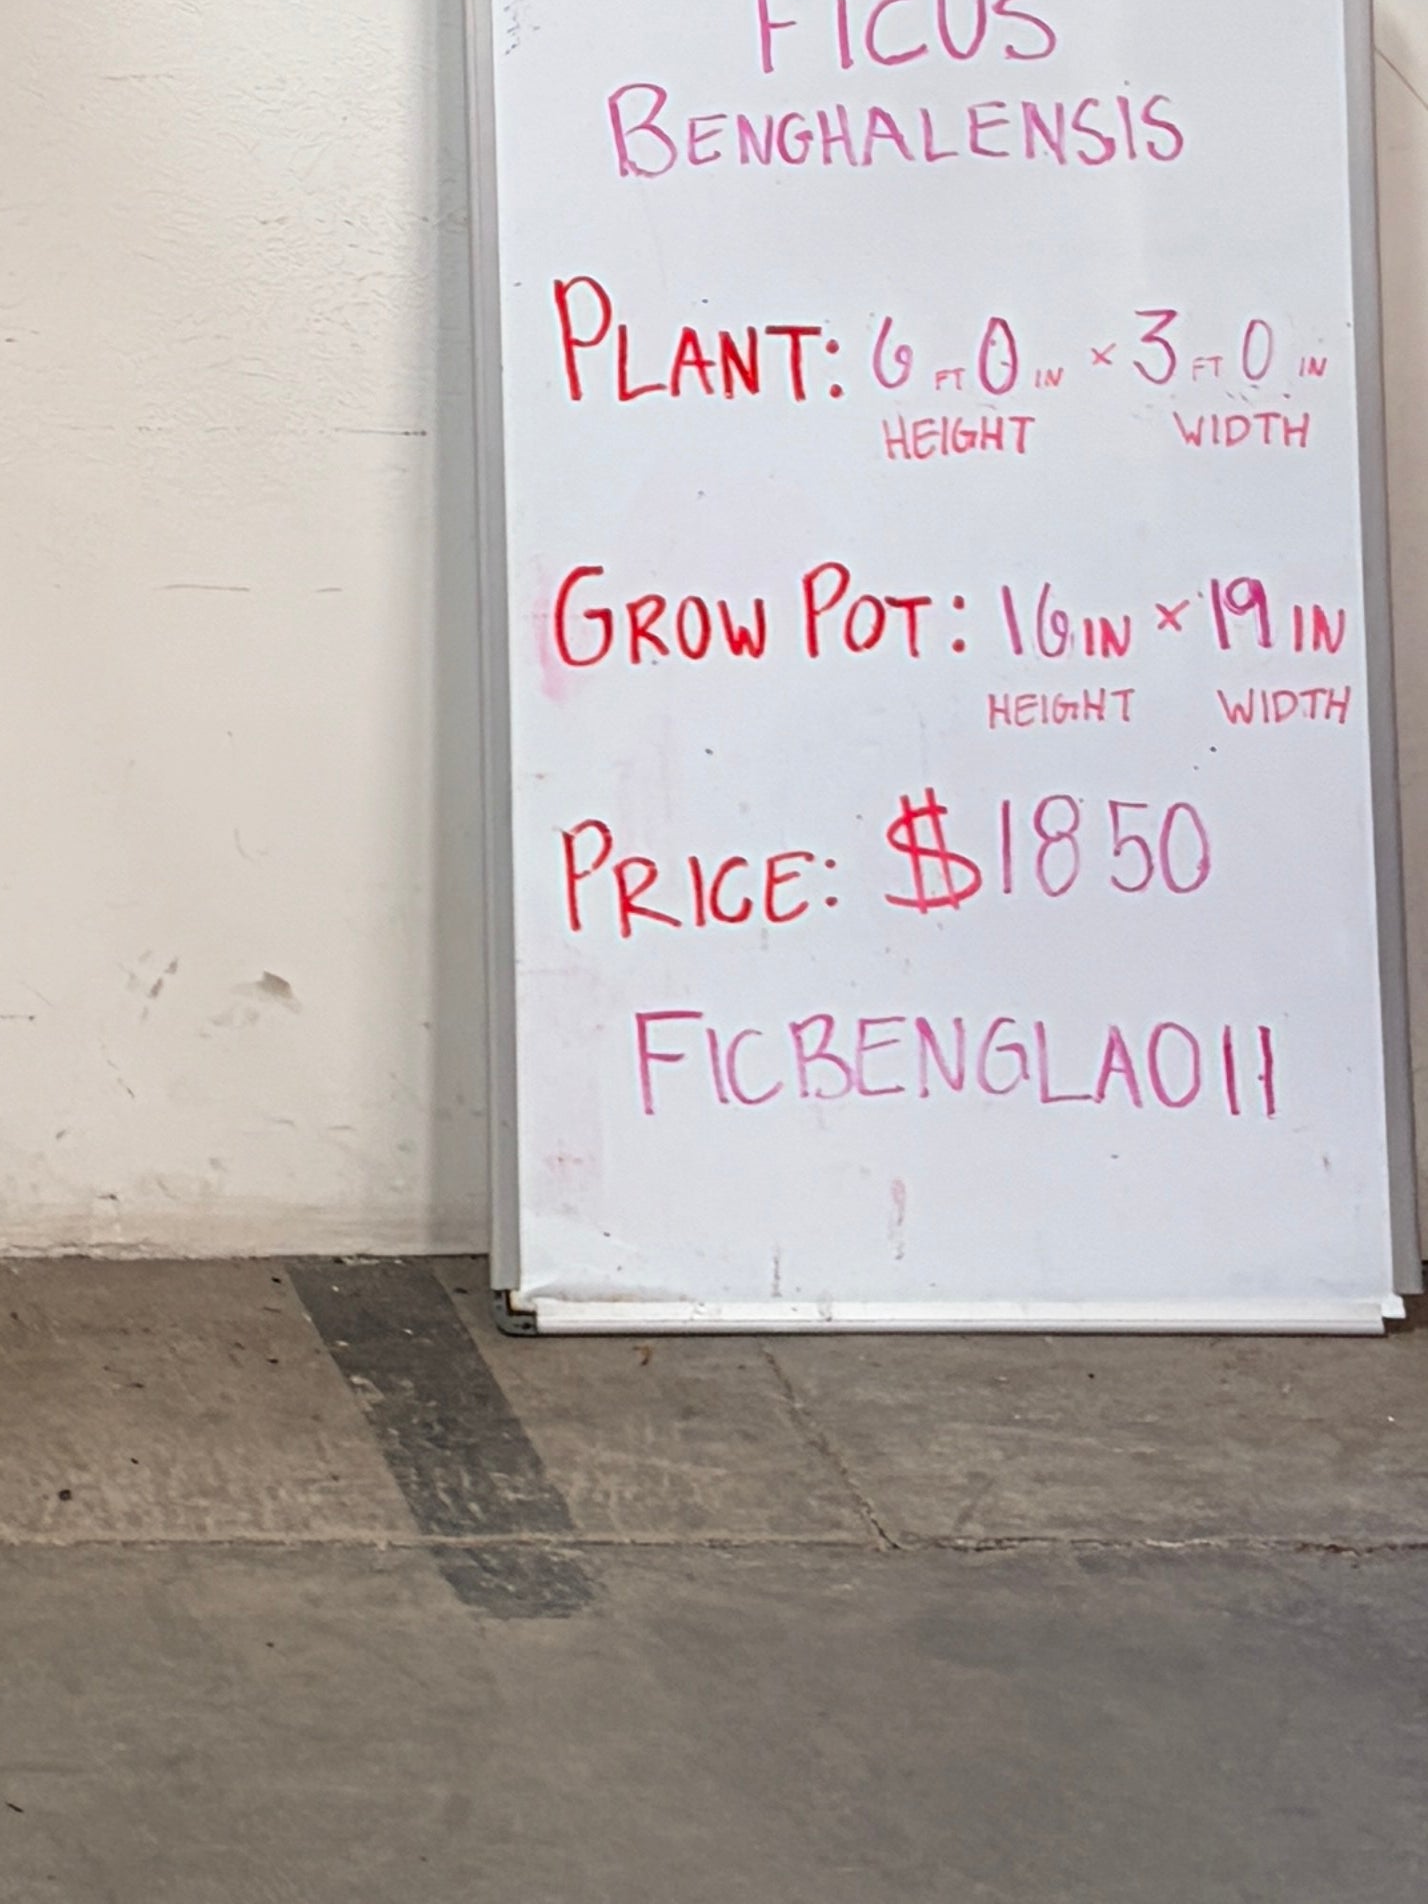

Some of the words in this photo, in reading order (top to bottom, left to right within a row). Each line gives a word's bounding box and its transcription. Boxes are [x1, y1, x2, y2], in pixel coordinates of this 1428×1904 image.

[607, 83, 1184, 177] BENGHALENSIS
[552, 275, 843, 403] PLANT:
[872, 317, 912, 390] 6
[934, 367, 965, 392] FT
[1136, 308, 1178, 385] 3
[1191, 355, 1223, 382] FT
[884, 415, 1033, 461] HEIGHT
[1175, 411, 1310, 448] WIDTH
[553, 565, 768, 669] GROW
[800, 560, 966, 660] POT:
[987, 689, 1136, 728] HEIGHT
[1217, 687, 1351, 726] WIDTH
[561, 819, 838, 940] PRICE:
[884, 786, 1211, 916] $1850
